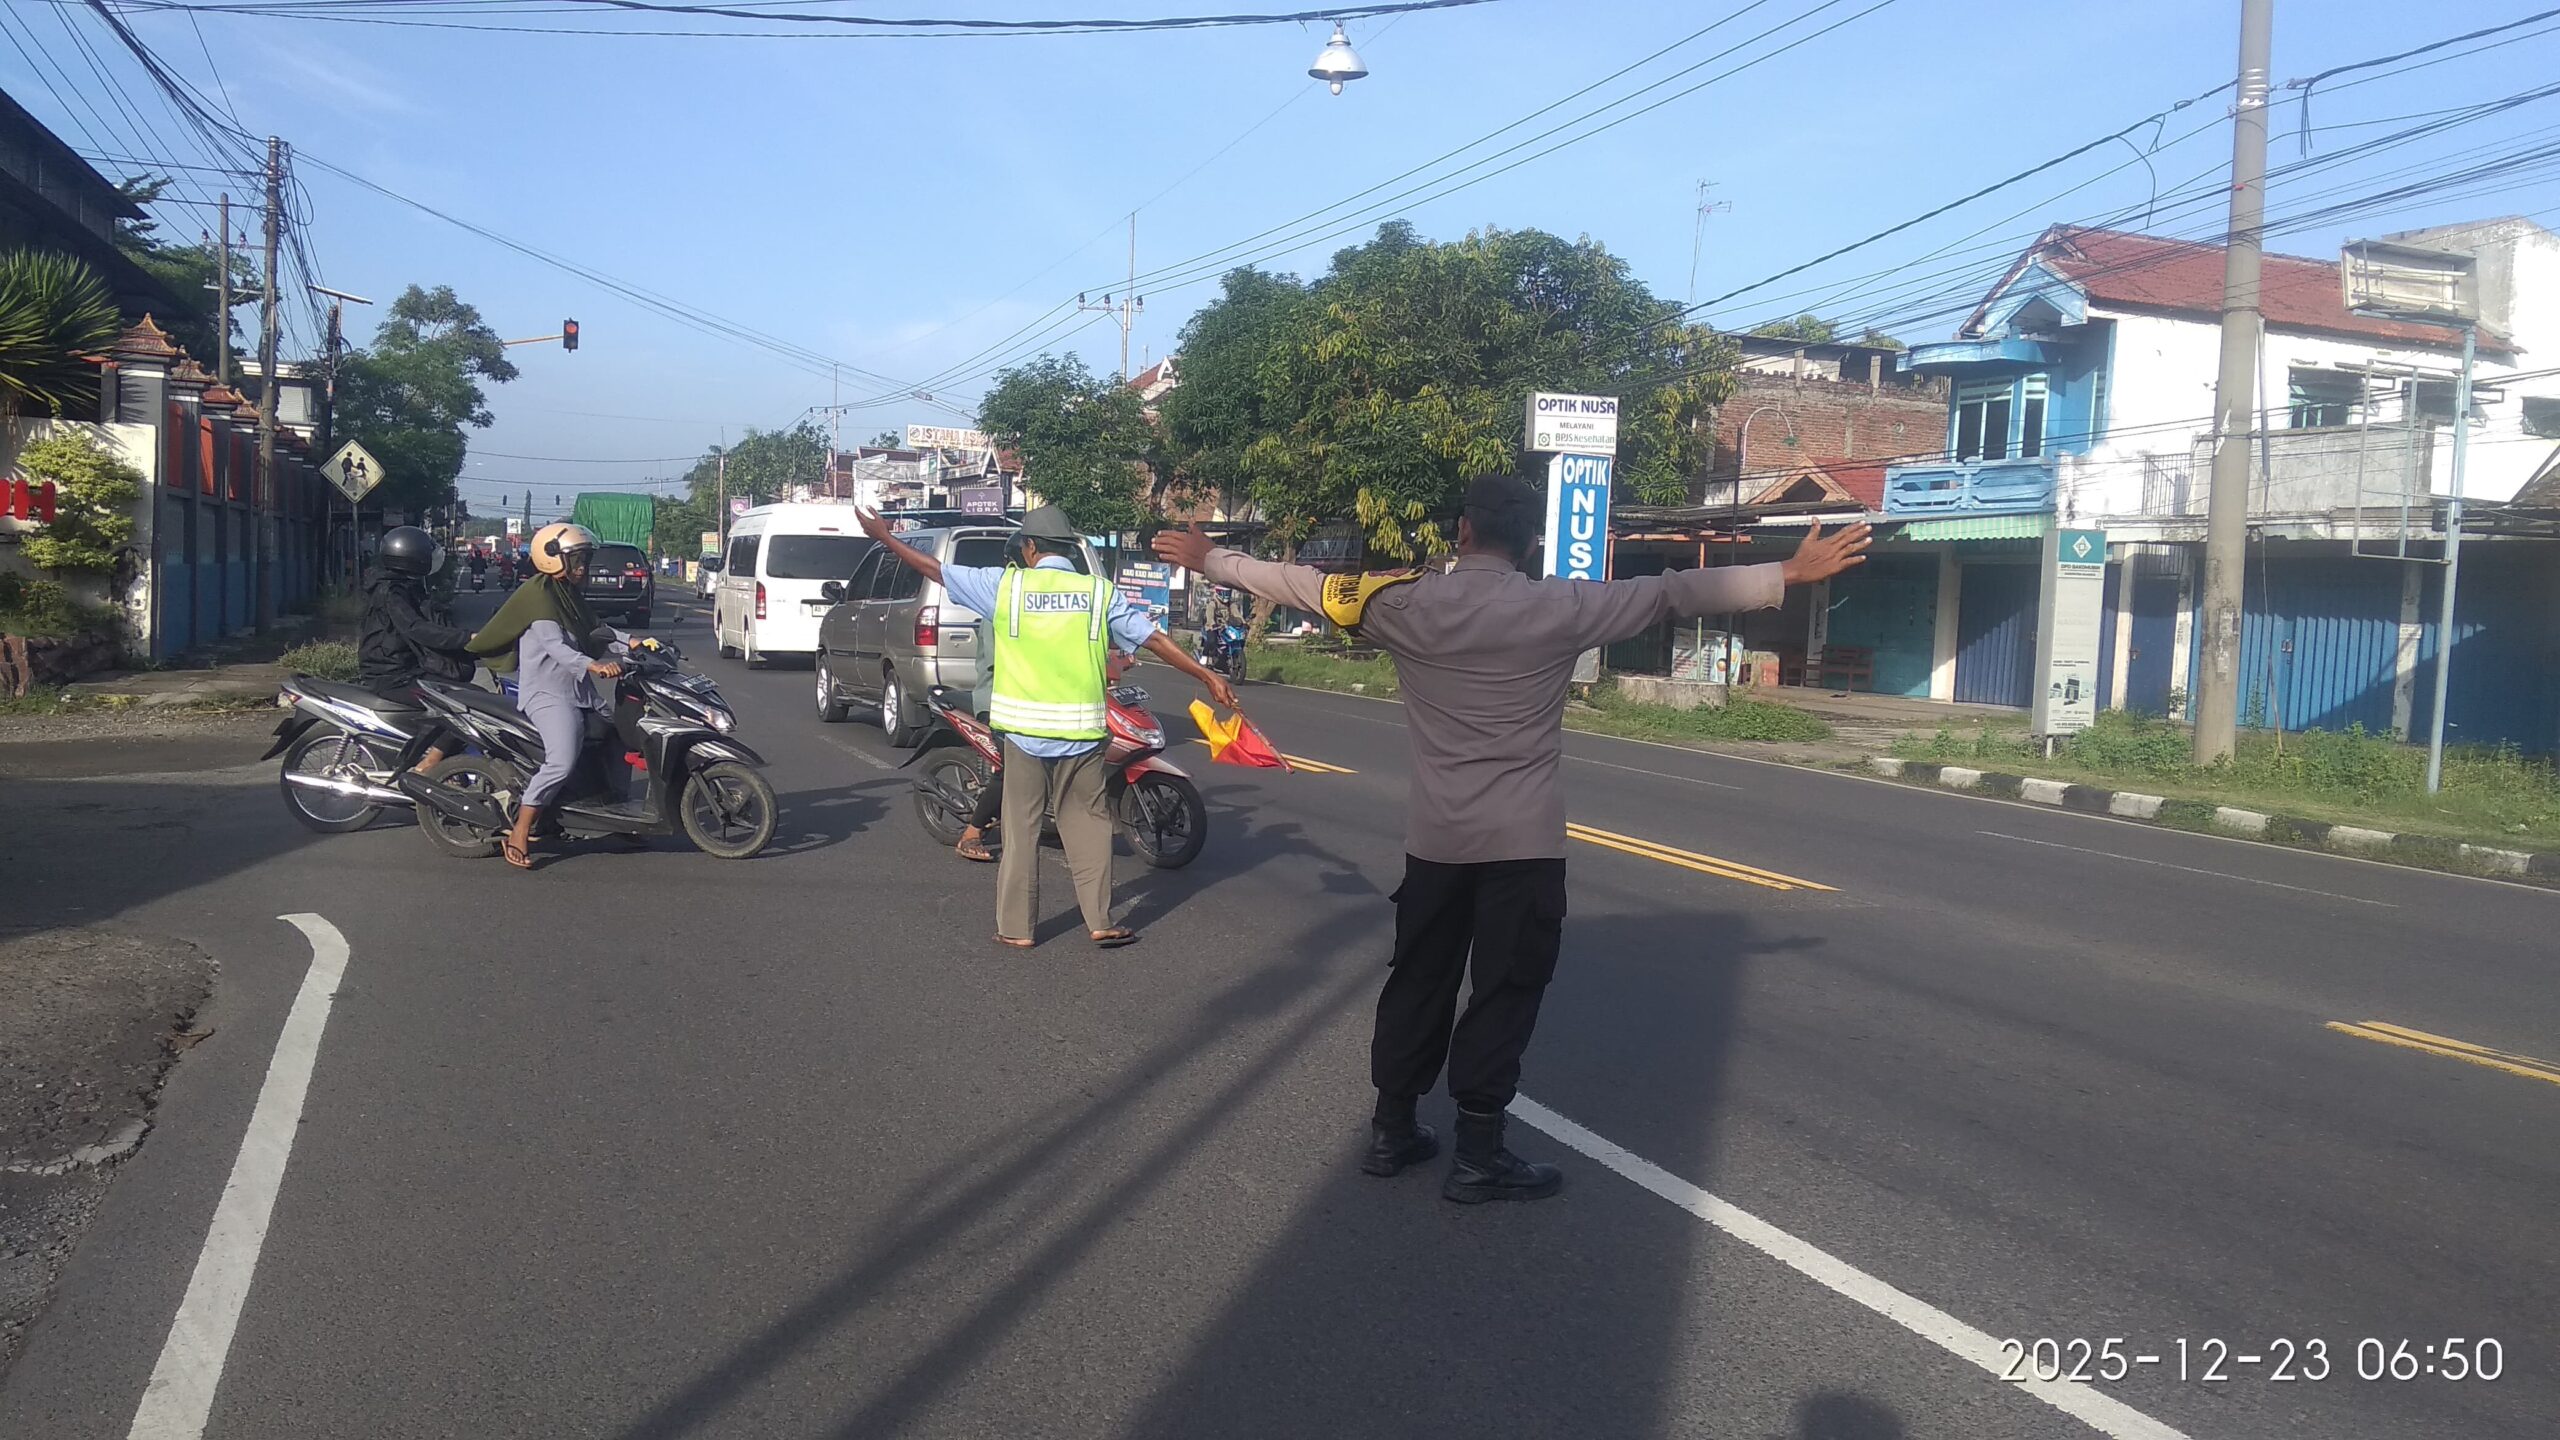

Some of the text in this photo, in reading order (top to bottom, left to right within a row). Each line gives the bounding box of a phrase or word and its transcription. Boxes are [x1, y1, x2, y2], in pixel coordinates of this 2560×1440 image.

[1537, 398, 1616, 414] OPTIK NUSA
[921, 427, 960, 441] ISTANA
[1559, 421, 1594, 431] MELAYANI
[1555, 432, 1615, 444] BPJS Kesehatan
[1563, 457, 1608, 486] OPTIK
[0, 478, 56, 525] H
[1026, 593, 1089, 609] SUPELTAS
